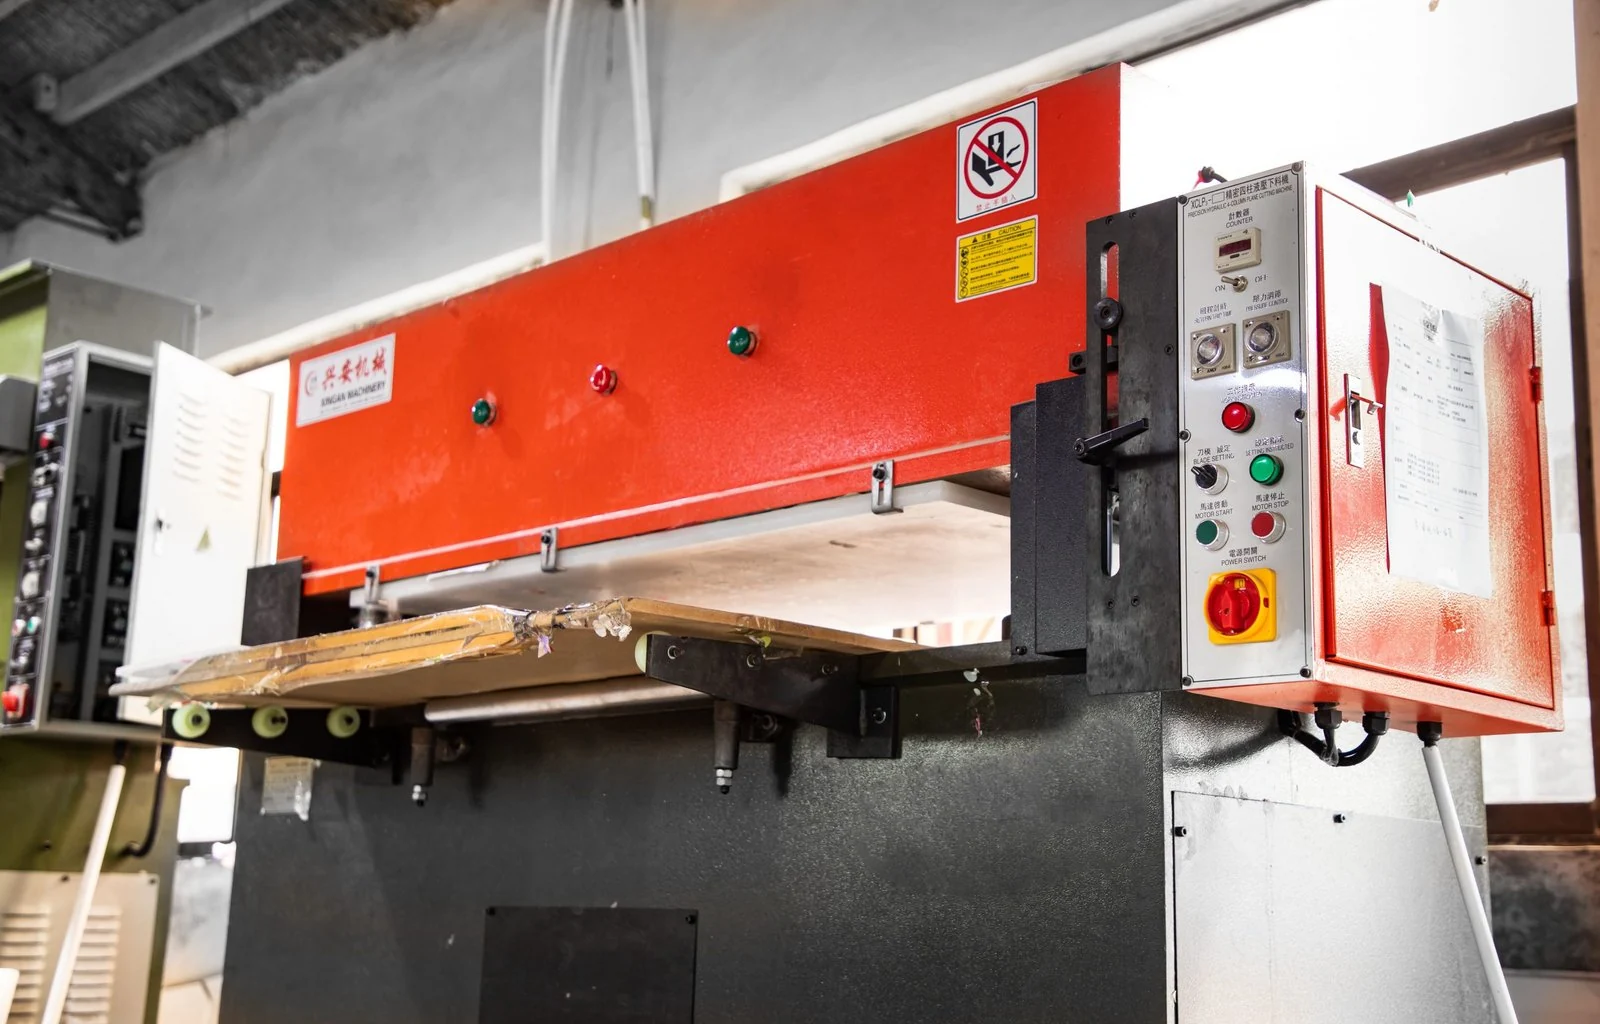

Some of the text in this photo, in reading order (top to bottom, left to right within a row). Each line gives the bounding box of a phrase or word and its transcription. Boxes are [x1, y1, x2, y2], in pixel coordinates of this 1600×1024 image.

[1225, 216, 1253, 228] COUNTER
[998, 224, 1022, 236] CAUTION
[1214, 284, 1226, 293] ON
[347, 381, 386, 399] MACHINERY
[1211, 452, 1235, 461] SETTING
[1255, 491, 1286, 502] 馬達停止
[1251, 499, 1290, 512] MOTOR STOP
[1194, 507, 1234, 520] MOTOR START
[1221, 554, 1267, 567] POWER SWITCH
